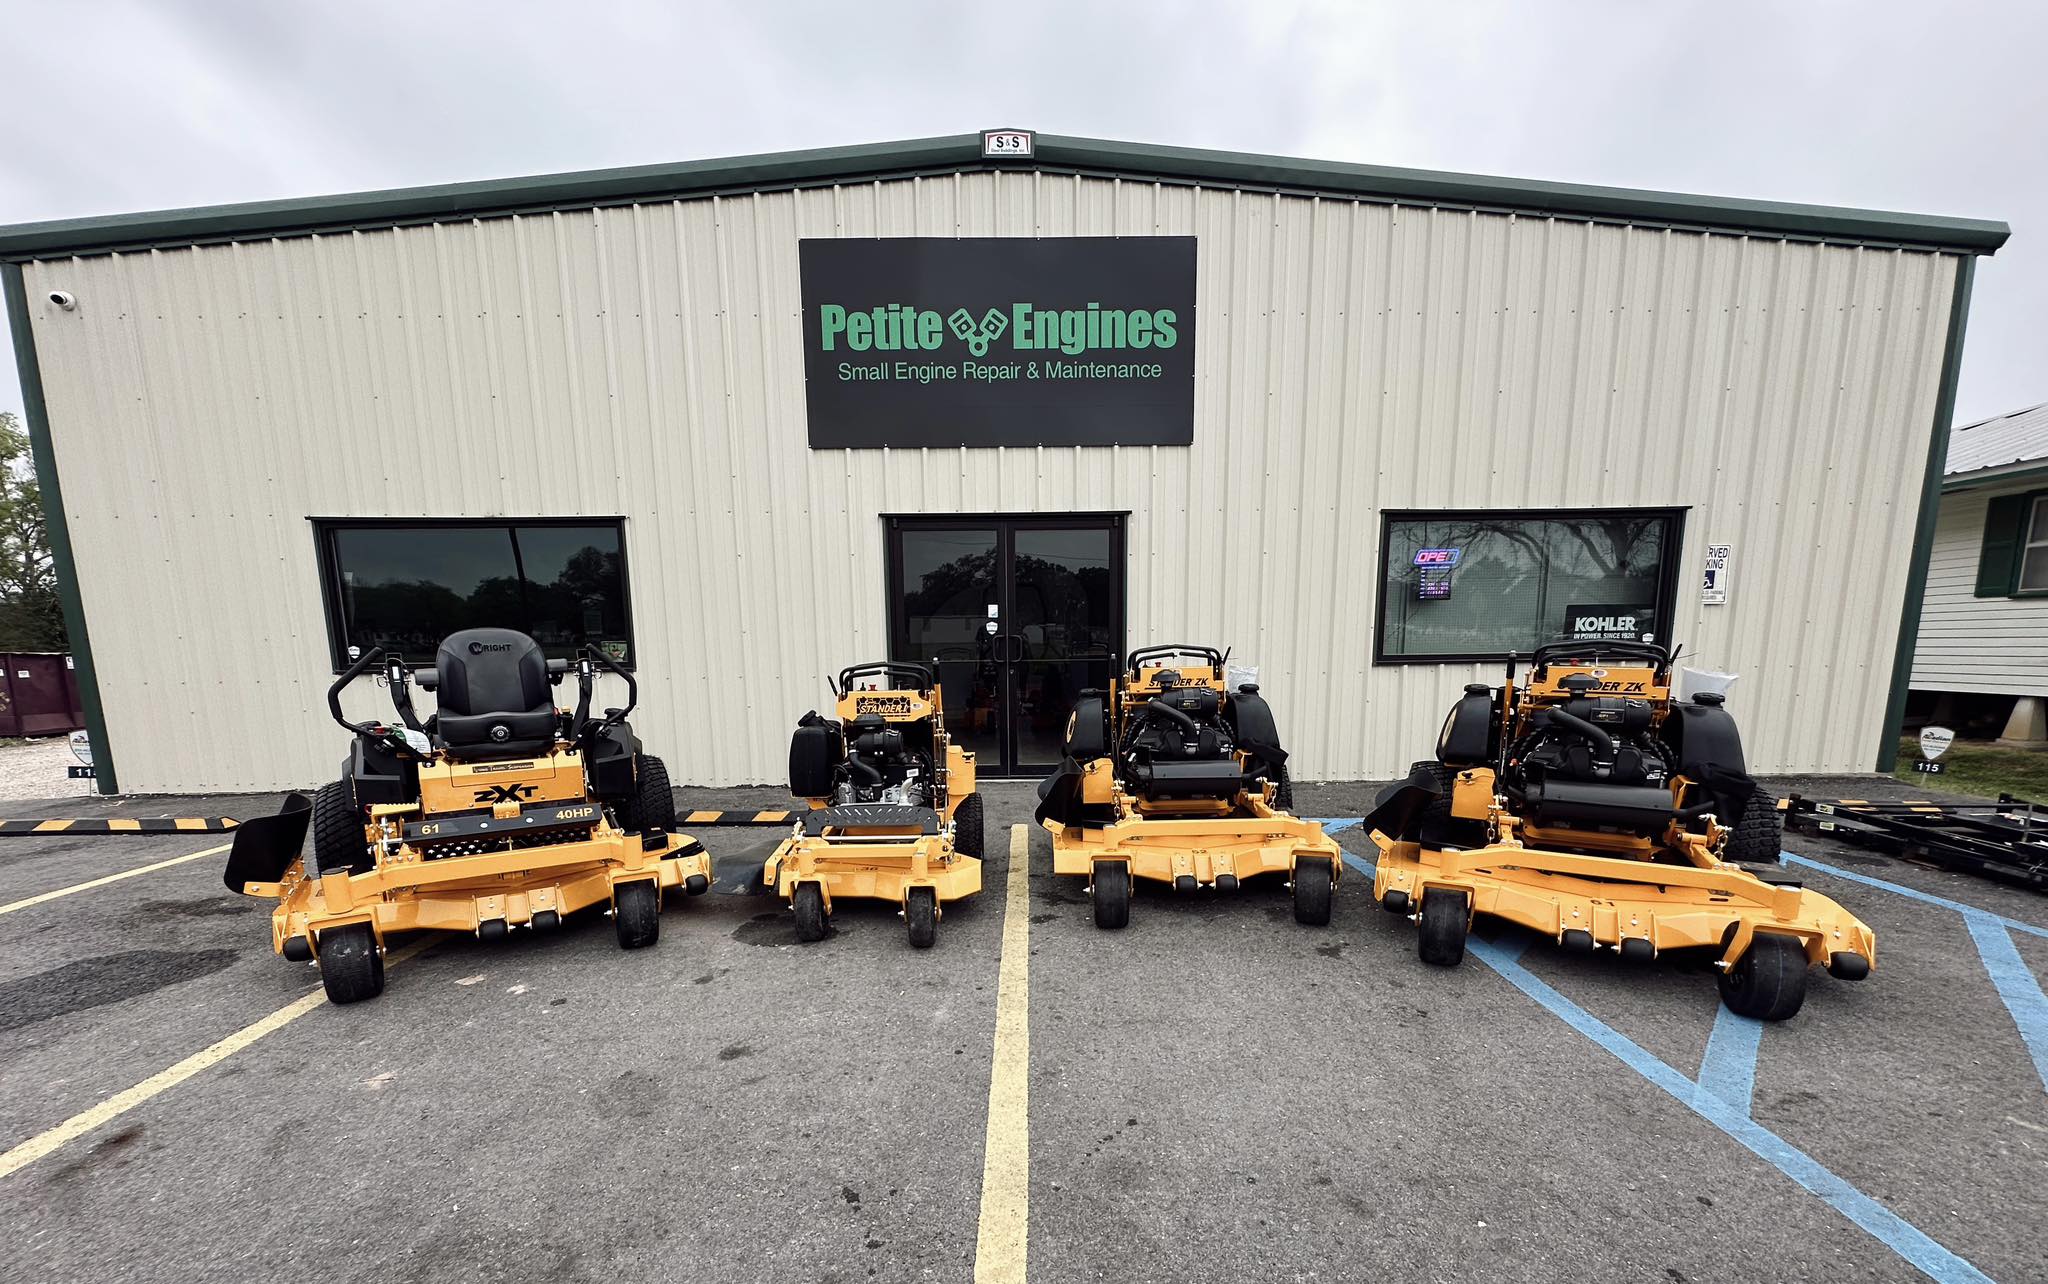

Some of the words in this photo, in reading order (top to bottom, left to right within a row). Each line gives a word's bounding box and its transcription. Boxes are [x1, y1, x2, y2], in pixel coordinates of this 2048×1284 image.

[996, 136, 1004, 148] S
[1012, 136, 1020, 148] S
[820, 303, 943, 351] Petite
[1012, 302, 1178, 355] Engines
[838, 362, 889, 380] Small
[895, 362, 957, 384] Engine
[963, 361, 1022, 384] Repair
[1026, 361, 1040, 379] &
[1045, 361, 1162, 379] Maintenance
[1574, 616, 1638, 632] KOHLER
[468, 642, 512, 656] WRIGHT
[1194, 678, 1209, 686] ZK
[1623, 681, 1646, 692] ZK
[860, 704, 902, 713] STANDER
[76, 768, 97, 777] 11
[1917, 762, 1940, 773] 115
[474, 783, 539, 806] ZXT
[421, 823, 439, 835] 61
[556, 807, 594, 820] 40HP
